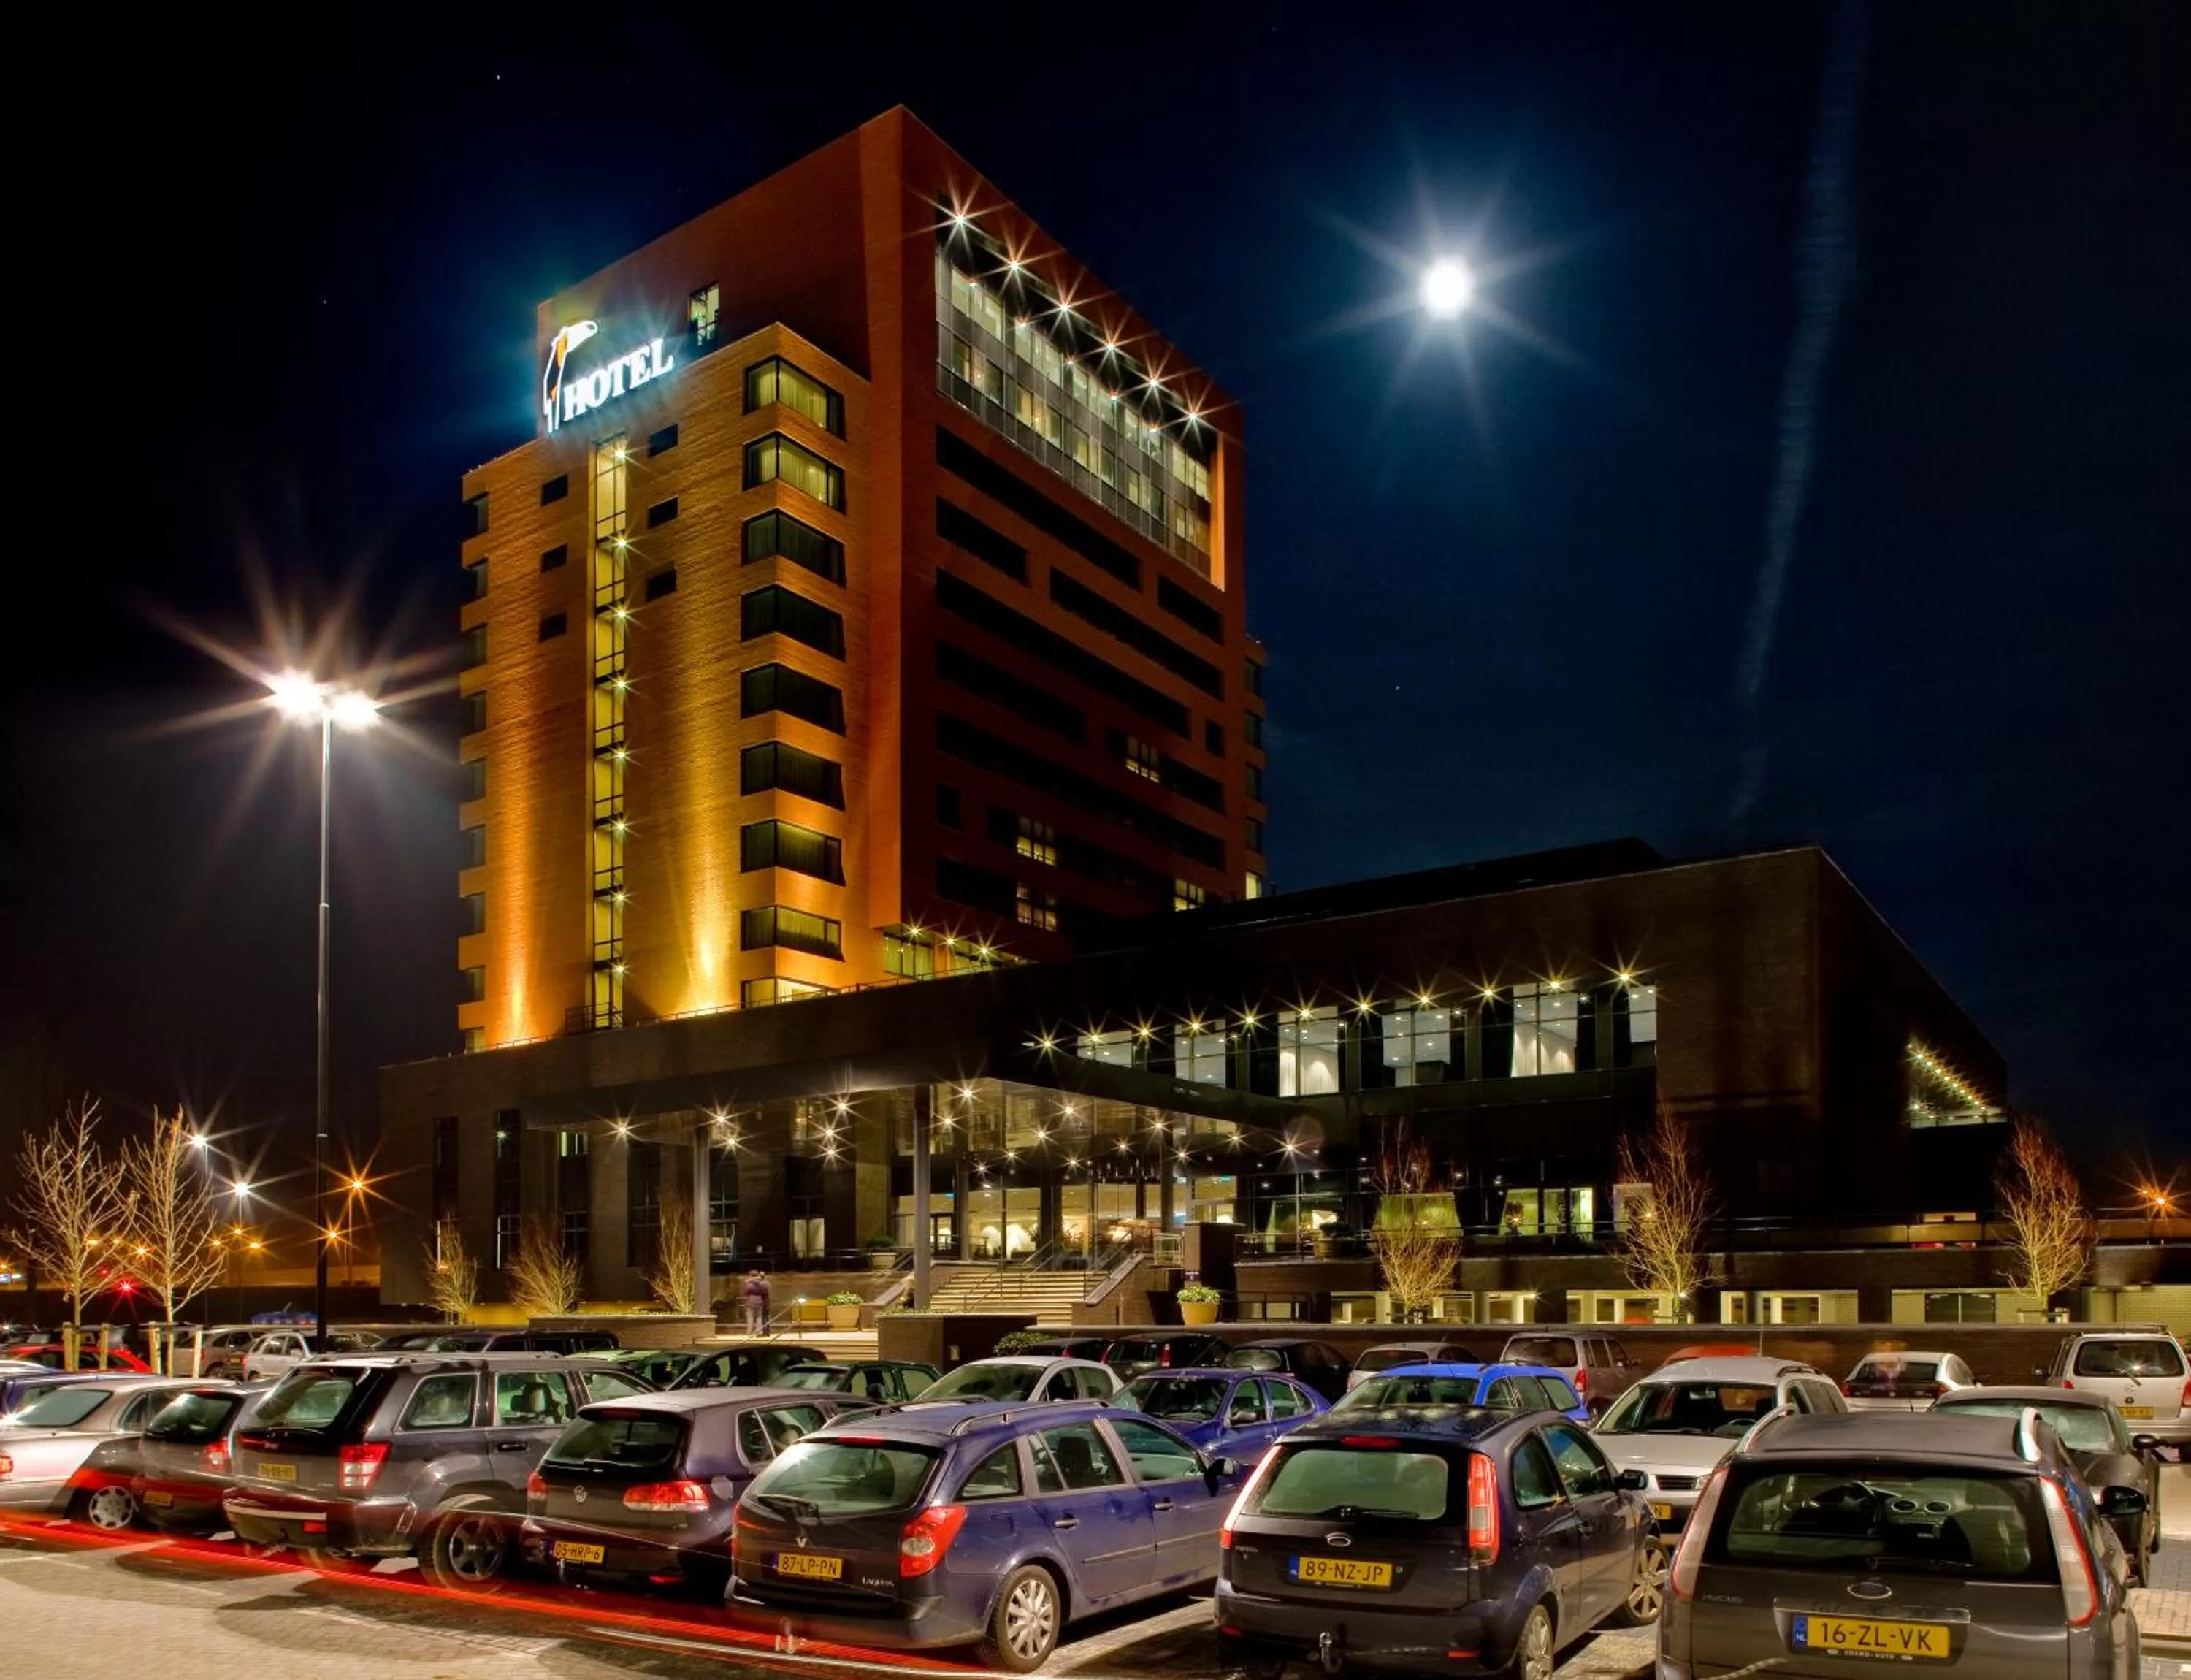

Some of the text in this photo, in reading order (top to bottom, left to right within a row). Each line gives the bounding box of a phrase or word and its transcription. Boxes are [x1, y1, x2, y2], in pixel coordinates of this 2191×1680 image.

[563, 338, 674, 421] HOTEL
[782, 1556, 838, 1576] 87-LP-PN
[1305, 1561, 1383, 1582] 89-NZ-JP
[1821, 1622, 1932, 1652] 16-ZL-VK
